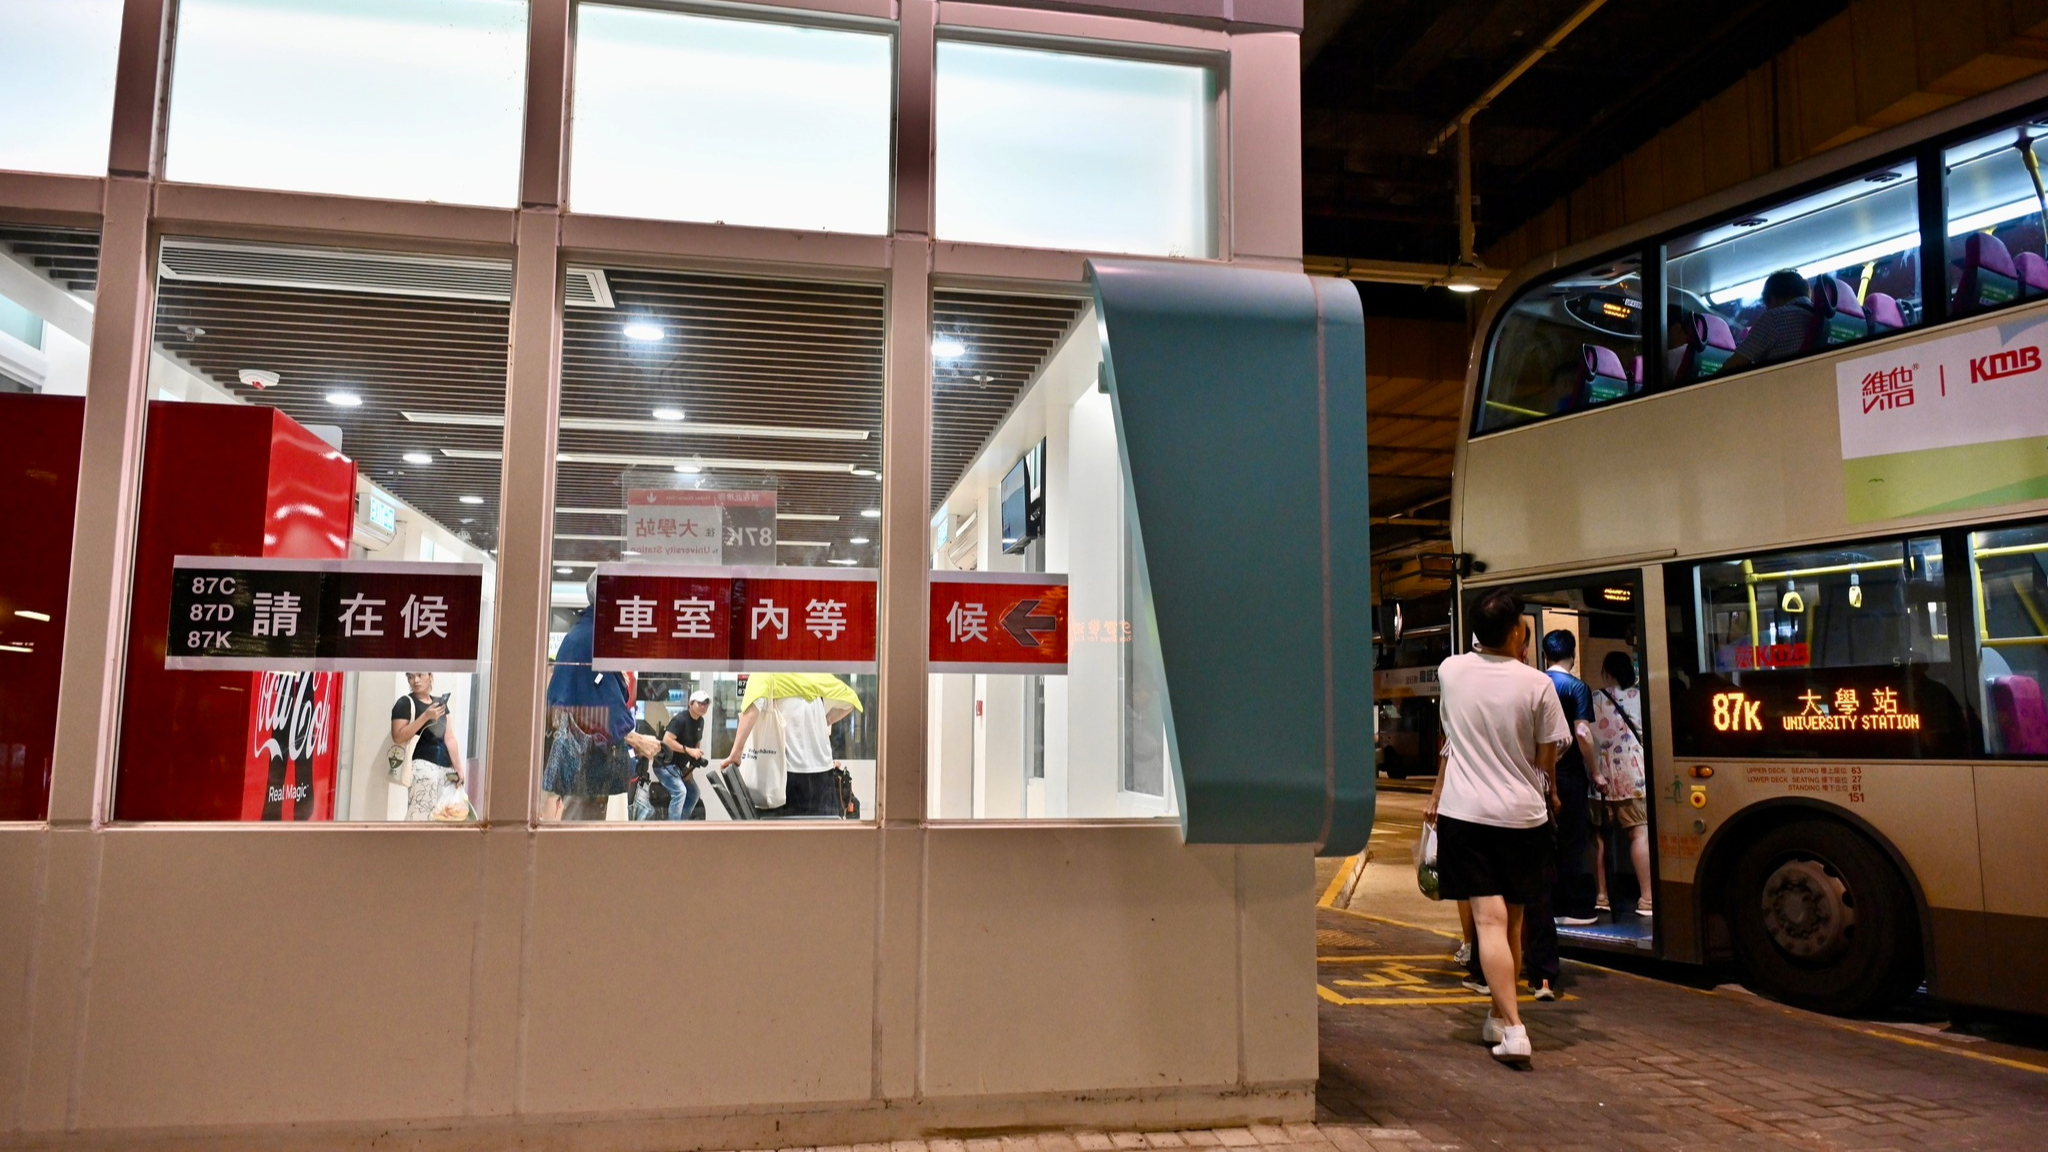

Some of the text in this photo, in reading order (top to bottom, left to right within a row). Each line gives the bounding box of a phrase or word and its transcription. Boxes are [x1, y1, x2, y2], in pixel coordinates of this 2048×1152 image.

[1969, 345, 2042, 384] KMB
[191, 576, 237, 596] 87C
[189, 603, 235, 622] 87D
[252, 591, 989, 643] 請在候 車室內等 候
[187, 630, 233, 650] 87K
[1797, 686, 1898, 716] 大學站
[1712, 692, 1763, 731] 87K
[1782, 713, 1920, 731] UNIVERSITY STATION
[1746, 767, 1819, 775] UPPER DECK SEATING
[1851, 766, 1862, 775] 63
[1852, 775, 1862, 784] 27
[1747, 776, 1769, 784] LOWER
[1770, 776, 1789, 784] DECK
[1788, 784, 1821, 792] STANDING
[1852, 784, 1862, 792] 61
[268, 782, 307, 802] Real Magic
[1848, 792, 1865, 803] 151
